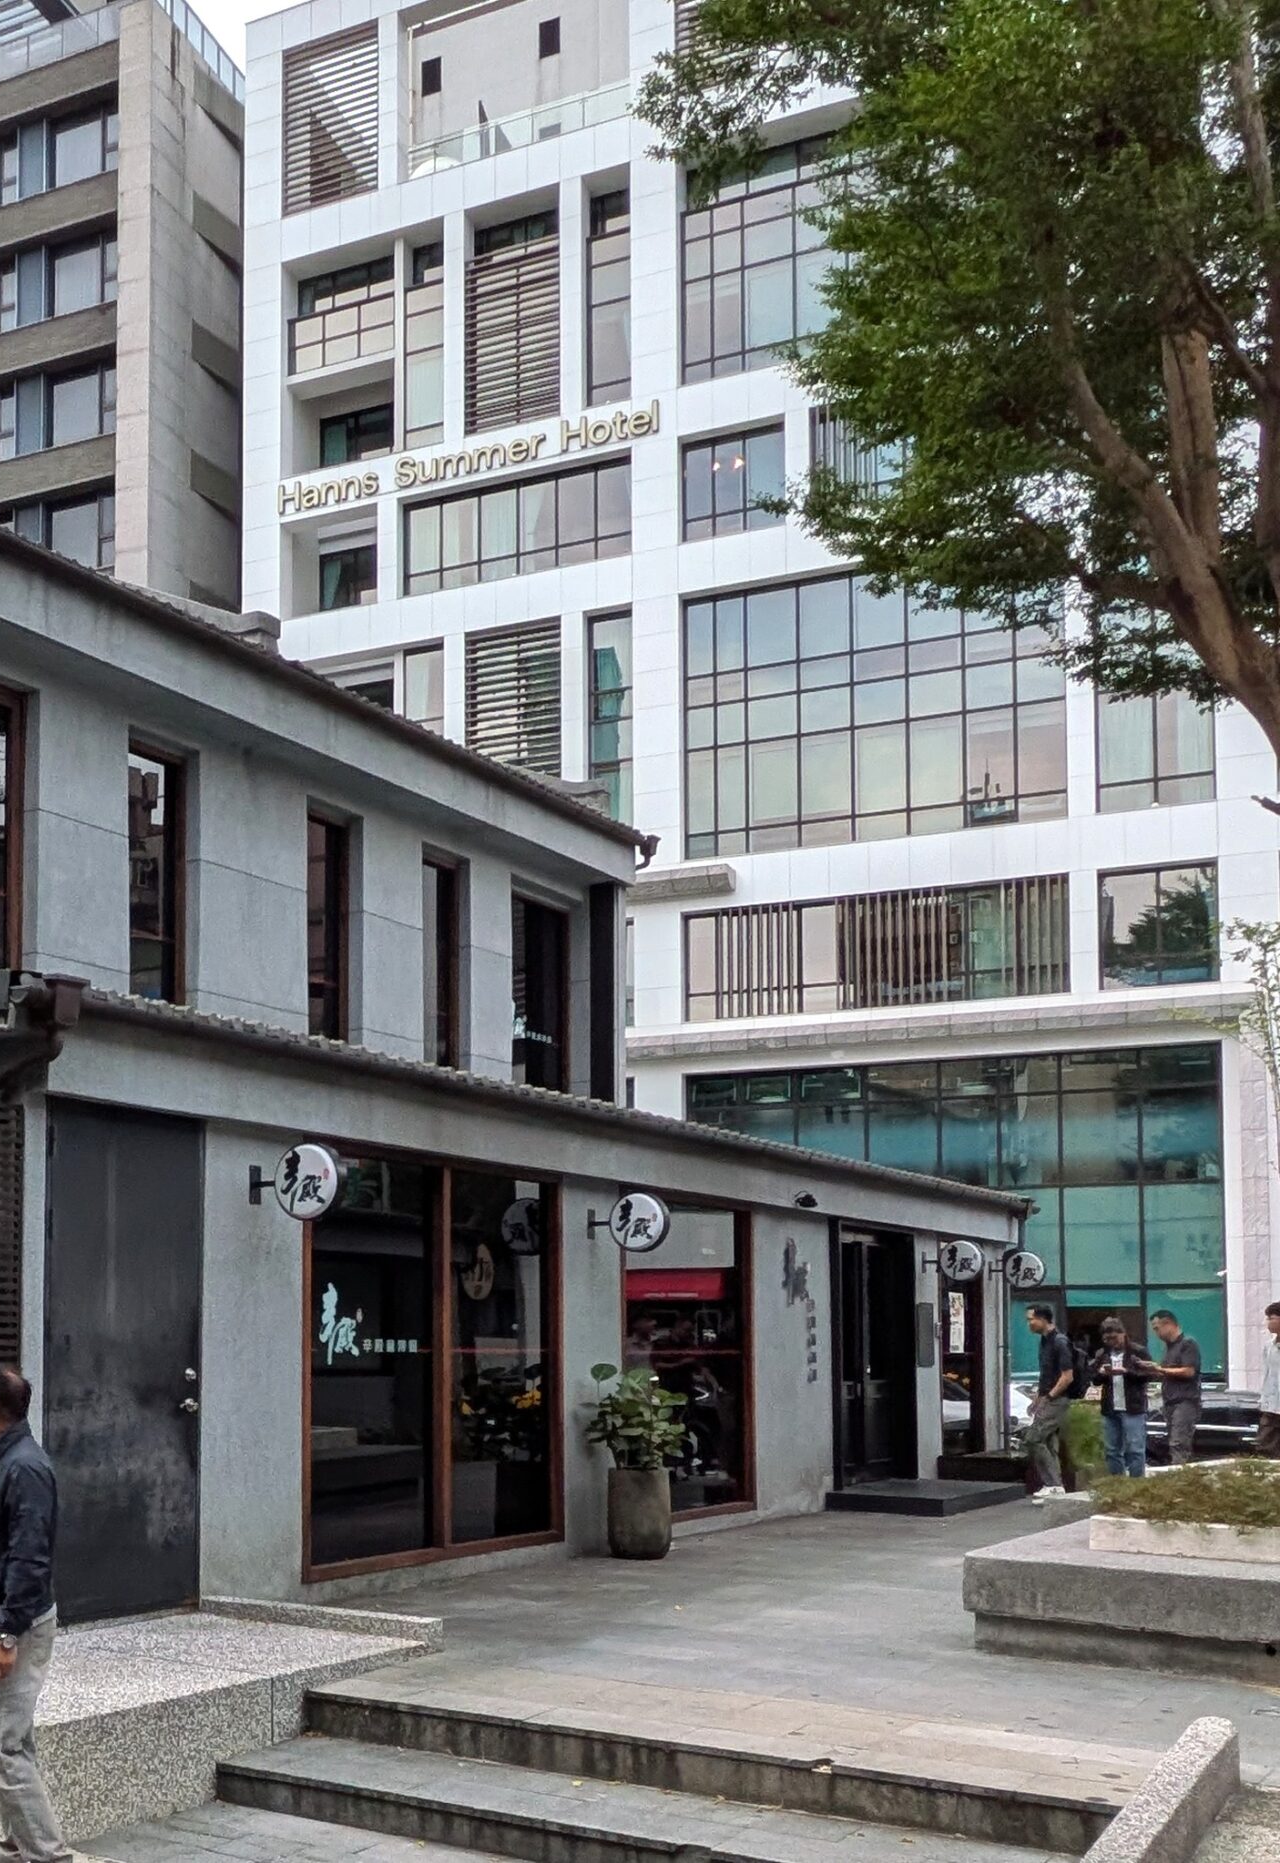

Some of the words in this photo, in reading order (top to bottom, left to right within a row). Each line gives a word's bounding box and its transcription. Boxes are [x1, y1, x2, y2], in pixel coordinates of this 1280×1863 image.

[278, 469, 380, 515] Hanns
[394, 433, 547, 488] Summer
[560, 399, 661, 452] Hotel
